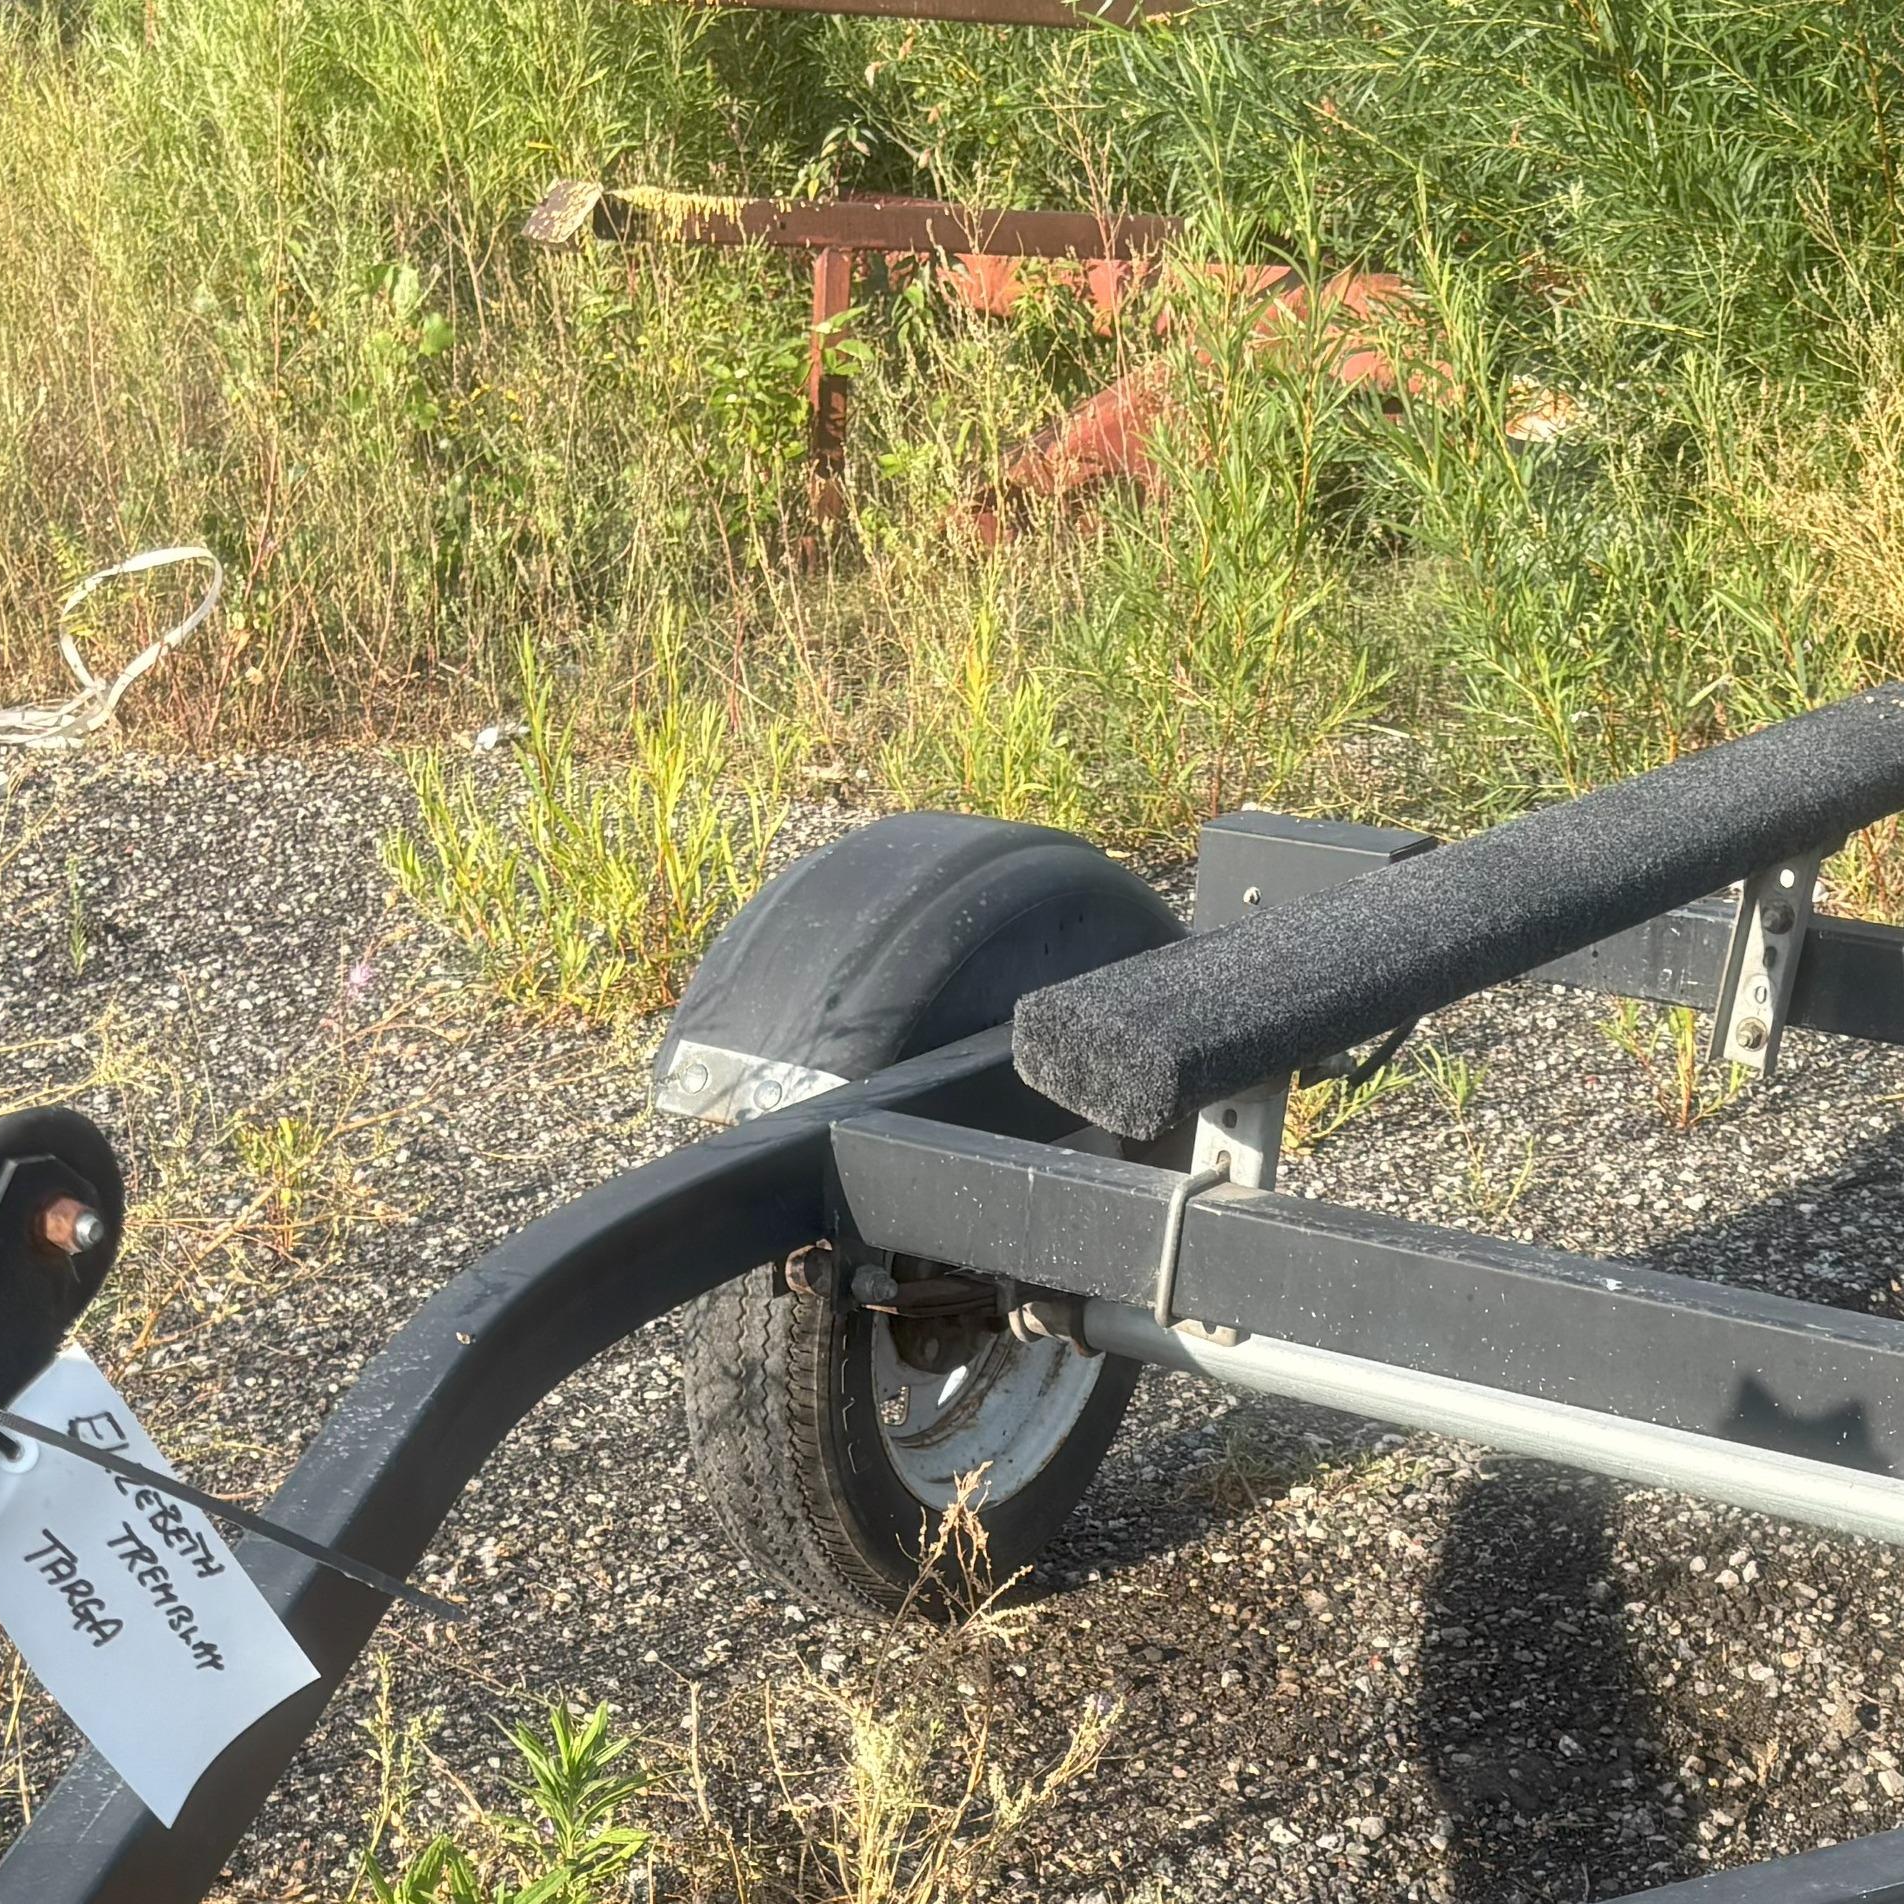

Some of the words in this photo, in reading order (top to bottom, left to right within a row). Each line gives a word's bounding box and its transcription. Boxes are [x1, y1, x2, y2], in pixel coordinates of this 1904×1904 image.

[68, 1411, 225, 1578] EZEBETH
[24, 1527, 123, 1648] TARGA
[107, 1521, 225, 1671] TREMBLAY
